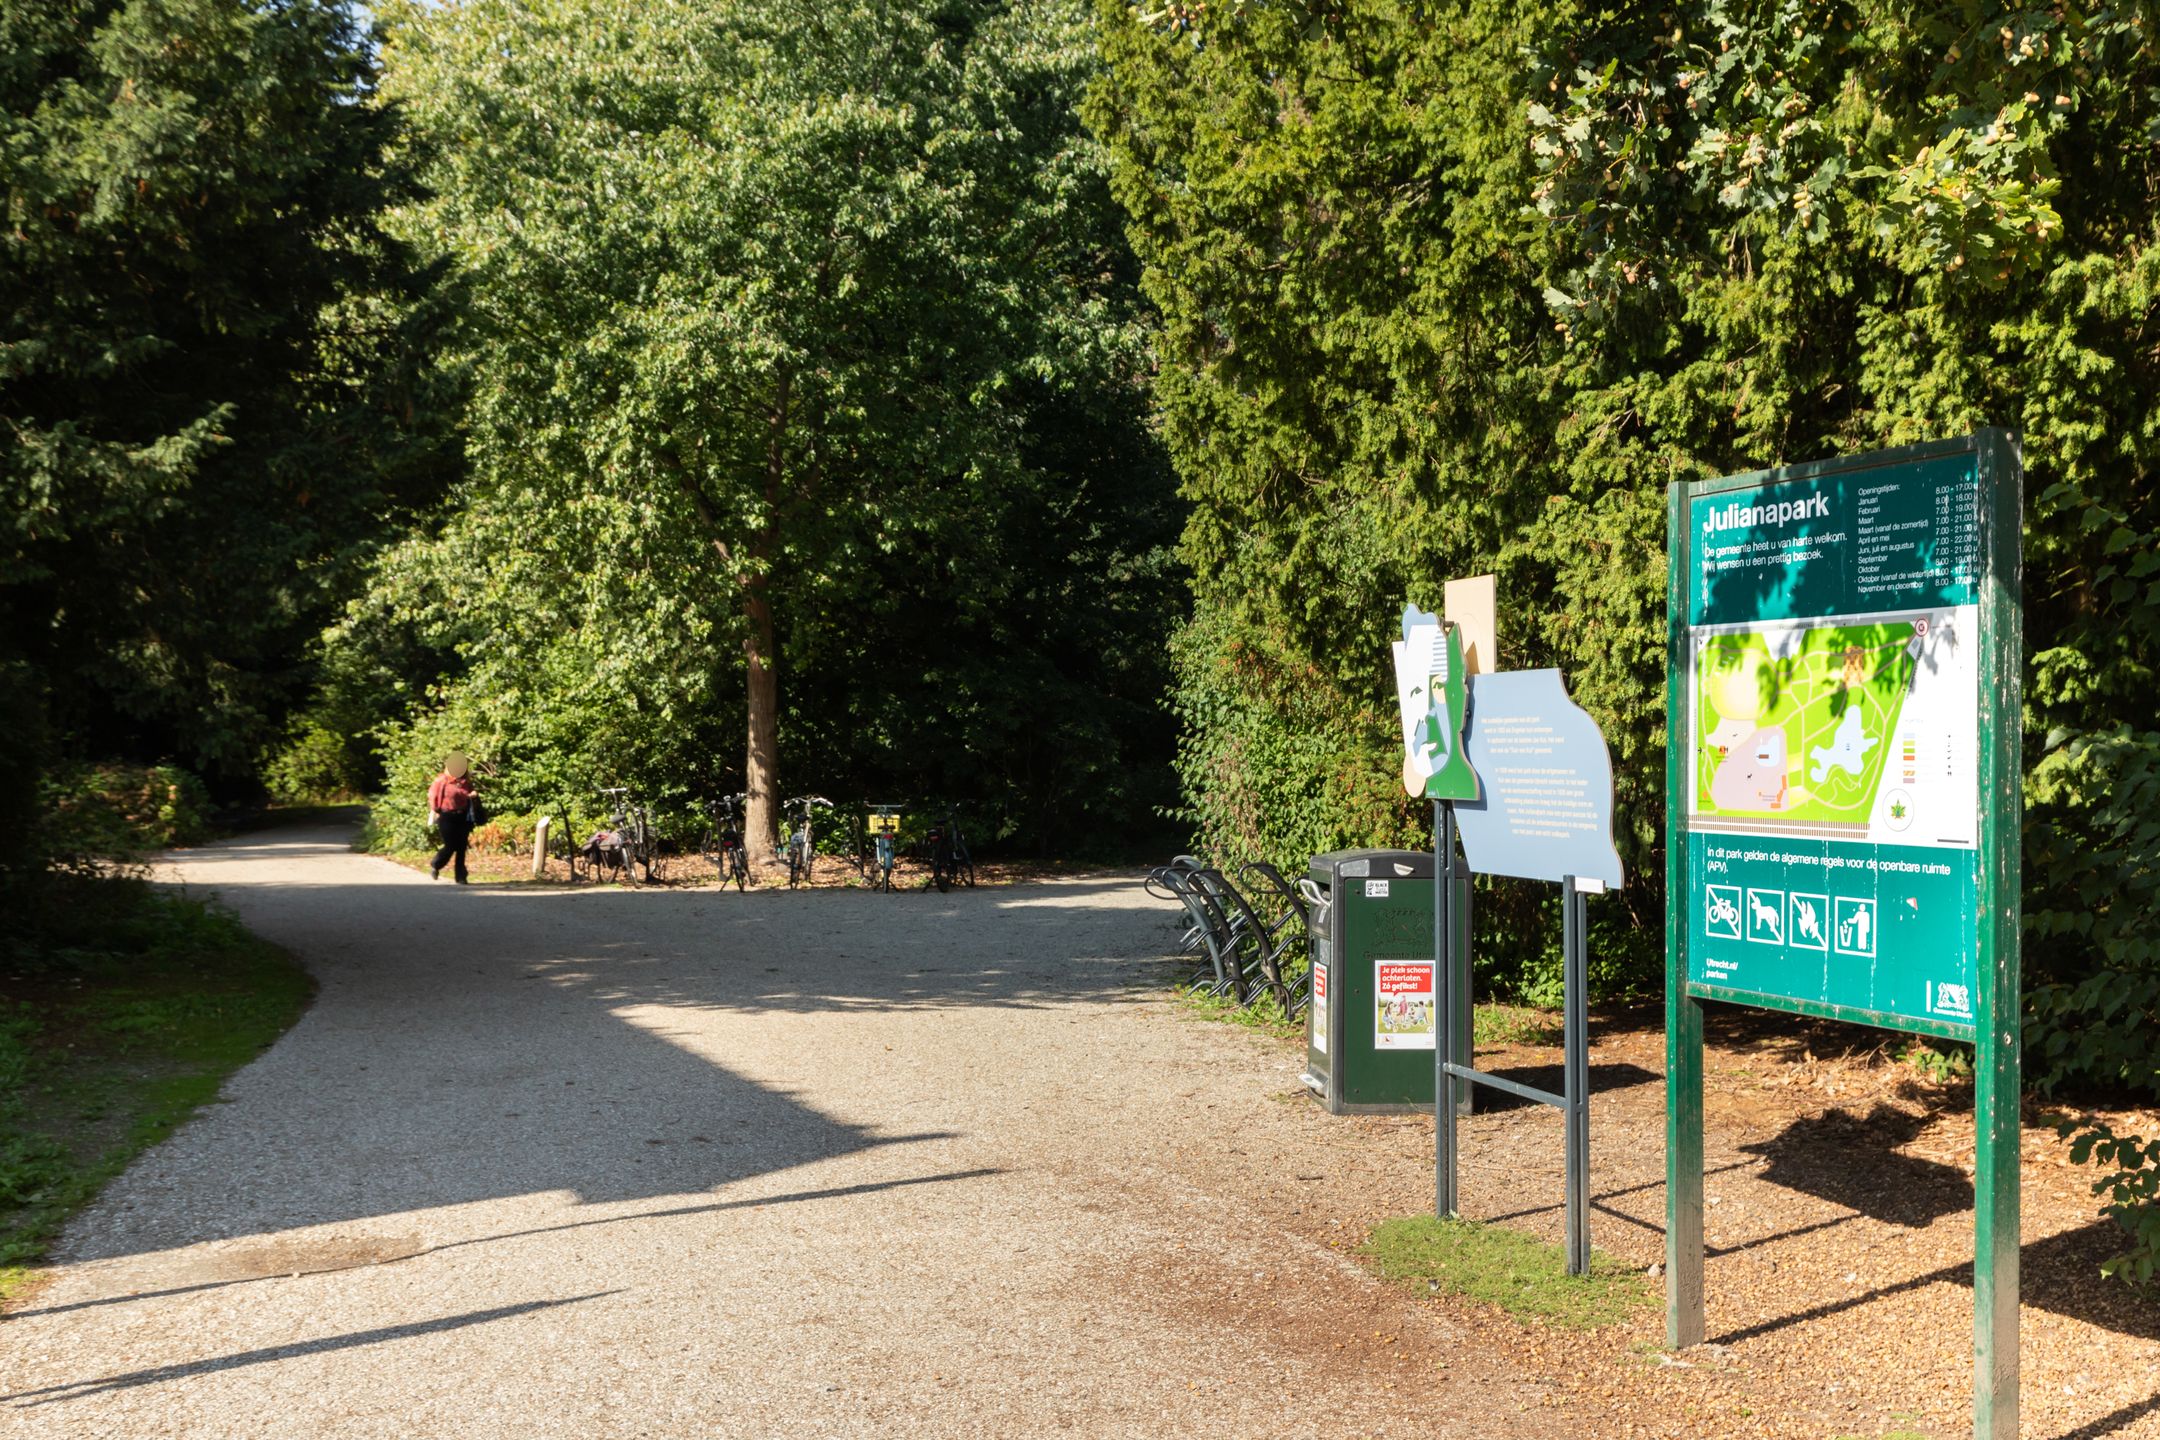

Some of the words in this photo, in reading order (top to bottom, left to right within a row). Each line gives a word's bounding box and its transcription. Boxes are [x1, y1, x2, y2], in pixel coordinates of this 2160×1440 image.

[1858, 484, 1900, 496] Openingstijden:
[1858, 496, 1878, 506] Januari
[1935, 486, 1950, 495] 8.00
[1955, 482, 1973, 492] 17.00
[1702, 491, 1830, 532] Julianapark
[1858, 506, 1880, 515] Februari
[1935, 496, 1950, 505] 8.00
[1955, 493, 1973, 502] 18.00
[1858, 516, 1874, 525] Maart
[1935, 506, 1950, 515] 7.00
[1955, 504, 1973, 512] 19.00
[1858, 526, 1874, 535] Maart
[1875, 524, 1892, 534] (vanaf
[1892, 522, 1900, 531] de
[1901, 518, 1929, 529] zomertijd)
[1935, 516, 1950, 525] 7.00
[1955, 514, 1973, 523] 21.00
[1858, 536, 1870, 544] April
[1880, 534, 1890, 542] mei
[1935, 526, 1950, 535] 7.00
[1955, 524, 1973, 533] 21.00
[1858, 546, 1870, 554] Juni,
[1880, 544, 1888, 552] en
[1889, 542, 1914, 552] augustus
[1935, 537, 1949, 546] 7.00
[1955, 534, 1973, 544] 22.00
[1704, 546, 1714, 558] De
[1716, 543, 1751, 558] gemeente
[1752, 542, 1769, 552] heet
[1771, 542, 1776, 550] u
[1777, 540, 1792, 548] van
[1792, 536, 1813, 547] harte
[1814, 532, 1848, 544] welkom.
[1858, 555, 1888, 564] September
[1935, 548, 1949, 556] 7.00
[1955, 544, 1973, 554] 21.00
[1702, 560, 1716, 572] Wij
[1716, 559, 1744, 570] wensen
[1746, 558, 1750, 566] u
[1752, 556, 1766, 566] een
[1768, 553, 1792, 566] prettig
[1793, 550, 1824, 562] bezoek.
[1858, 565, 1880, 574] Oktober
[1935, 558, 1949, 566] 8.00
[1955, 554, 1973, 564] 19.00
[1858, 575, 1880, 584] Oktober
[1881, 573, 1898, 582] (vanaf
[1899, 572, 1906, 580] de
[1907, 569, 1934, 578] wintertijd)
[1935, 568, 1949, 576] 8.00
[1955, 565, 1973, 574] 17.00
[1858, 584, 1886, 593] November
[1895, 581, 1924, 590] december
[1935, 578, 1949, 586] 8.00
[1955, 575, 1973, 584] 17.00
[1707, 847, 1714, 857] In
[1716, 848, 1724, 858] dit
[1726, 849, 1742, 860] park
[1744, 850, 1768, 862] gelden
[1770, 851, 1780, 862] de
[1782, 852, 1819, 866] algemene
[1820, 856, 1844, 868] regels
[1846, 858, 1864, 868] voor
[1866, 858, 1878, 870] de
[1880, 860, 1920, 873] openbare
[1922, 862, 1952, 876] ruimte
[1707, 860, 1728, 874] (APV).
[1382, 974, 1422, 982] achterlaten.
[1390, 966, 1406, 974] plek
[1406, 966, 1430, 974] schoon
[1706, 970, 1728, 980] parken
